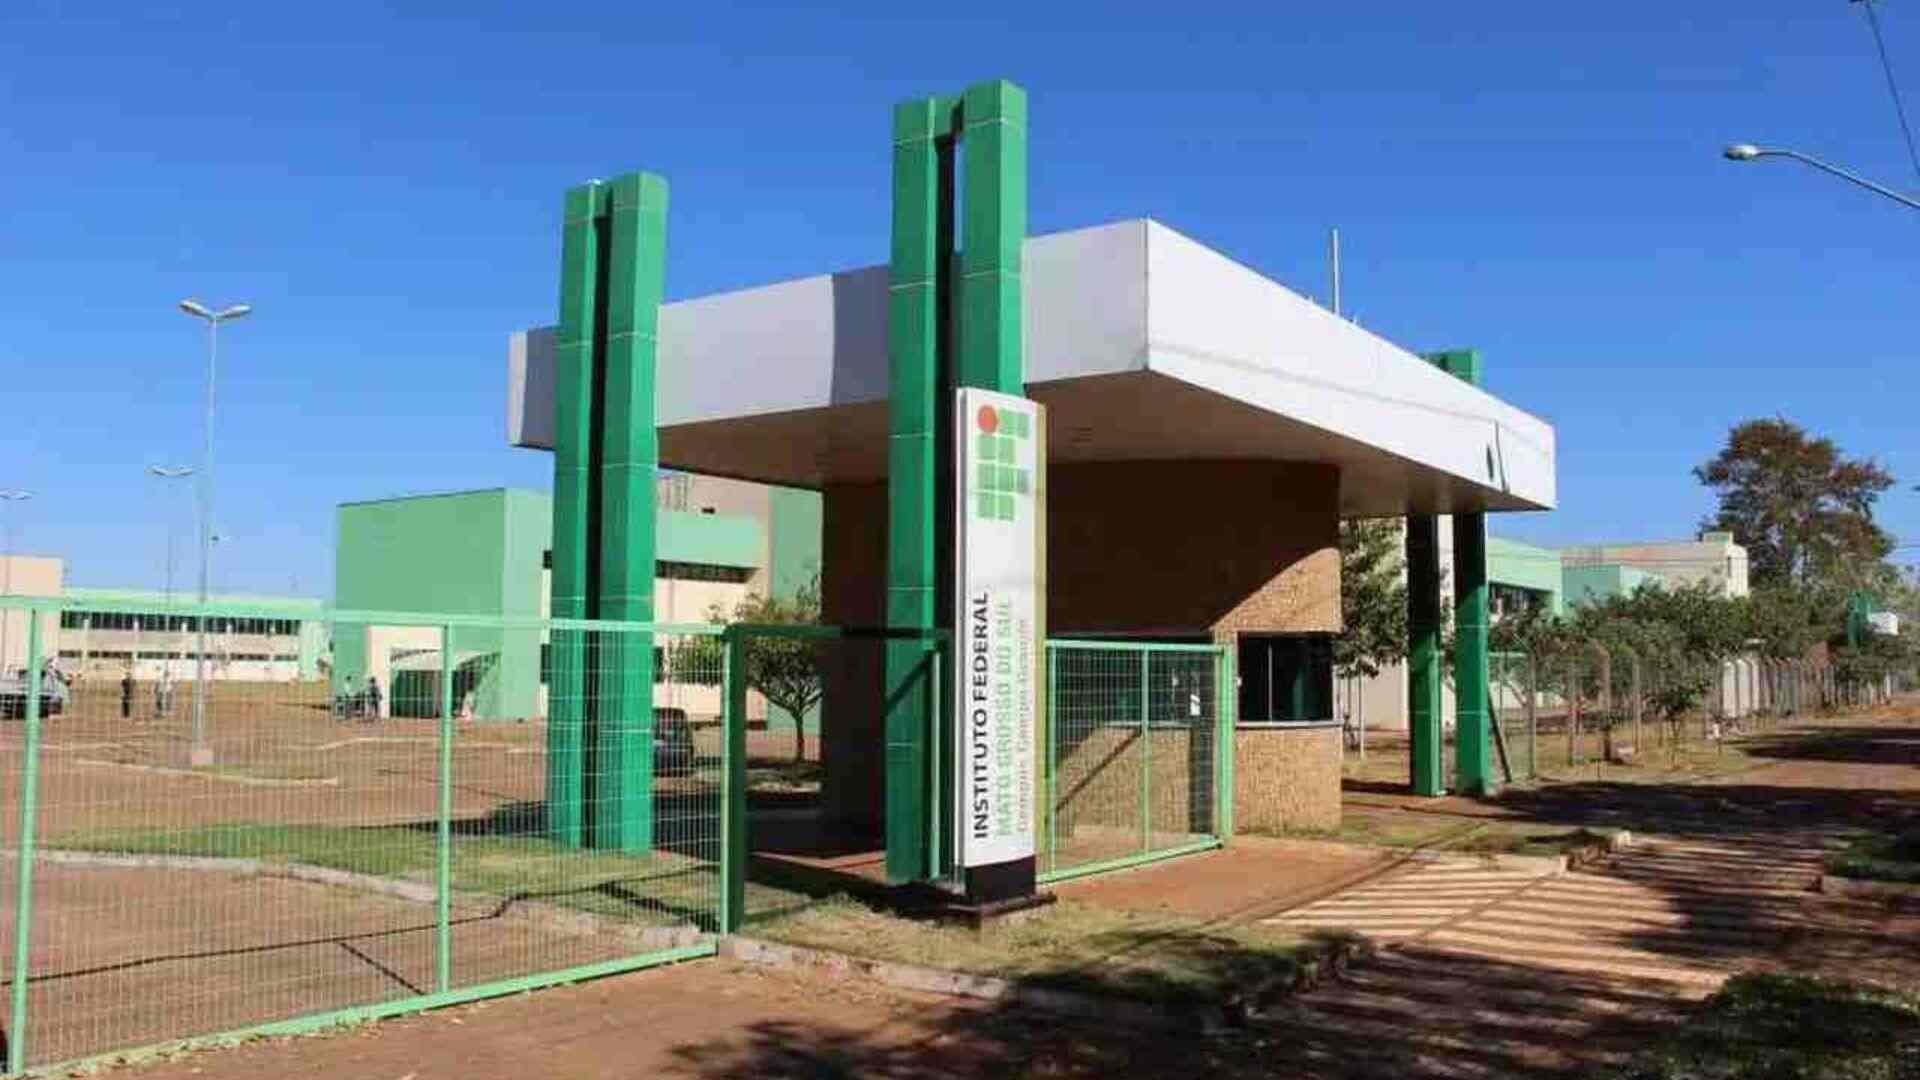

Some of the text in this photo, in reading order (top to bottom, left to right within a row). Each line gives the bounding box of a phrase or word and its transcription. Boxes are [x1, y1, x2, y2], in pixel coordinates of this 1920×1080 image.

[973, 593, 989, 839] INSTITUTO FEDERAL
[995, 598, 1011, 837] MATO GROSSO DO SUL
